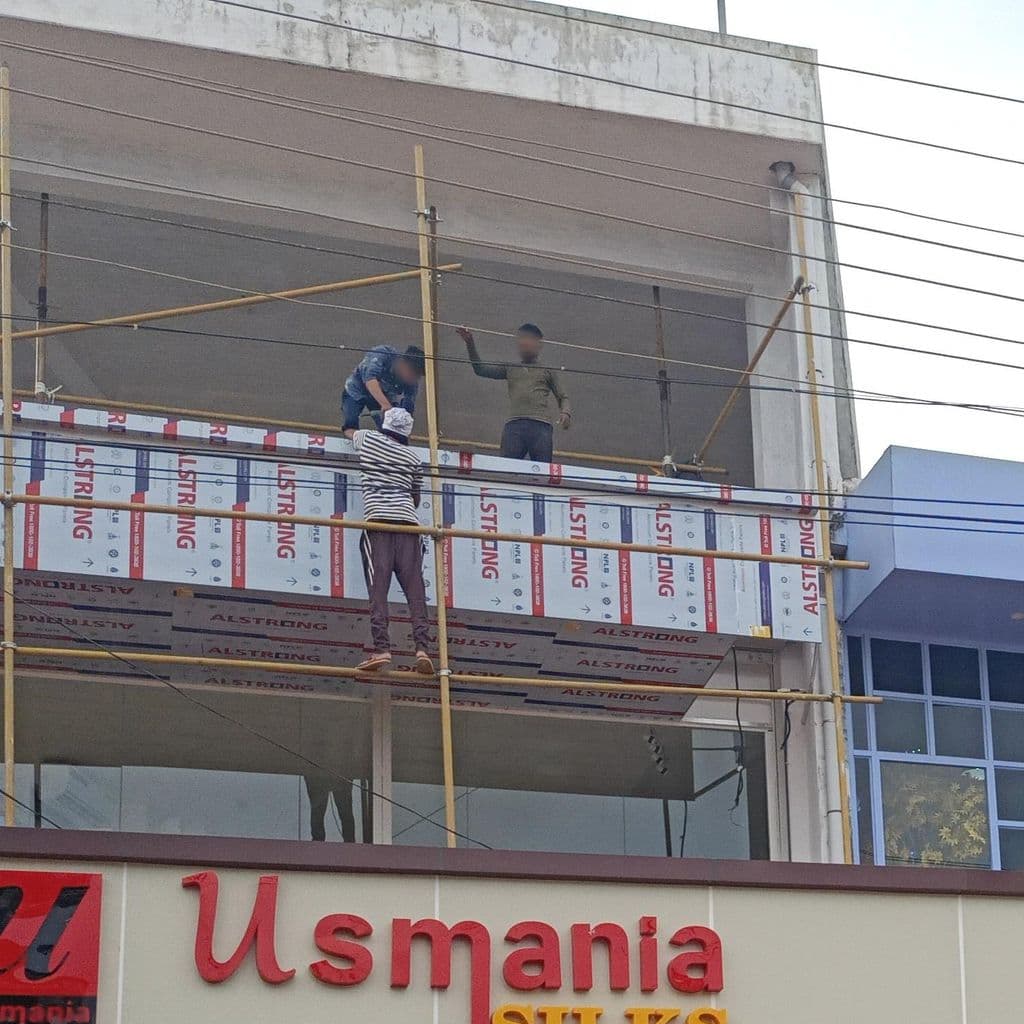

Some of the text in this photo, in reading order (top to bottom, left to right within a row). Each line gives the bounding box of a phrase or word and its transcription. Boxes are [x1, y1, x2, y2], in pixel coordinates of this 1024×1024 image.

[209, 614, 328, 631] ALSTRONG
[593, 627, 700, 643] ALSTRONG
[208, 647, 321, 662] ALSTRONG
[577, 659, 679, 674] ALSTRONG
[562, 688, 660, 701] ALSTRONG
